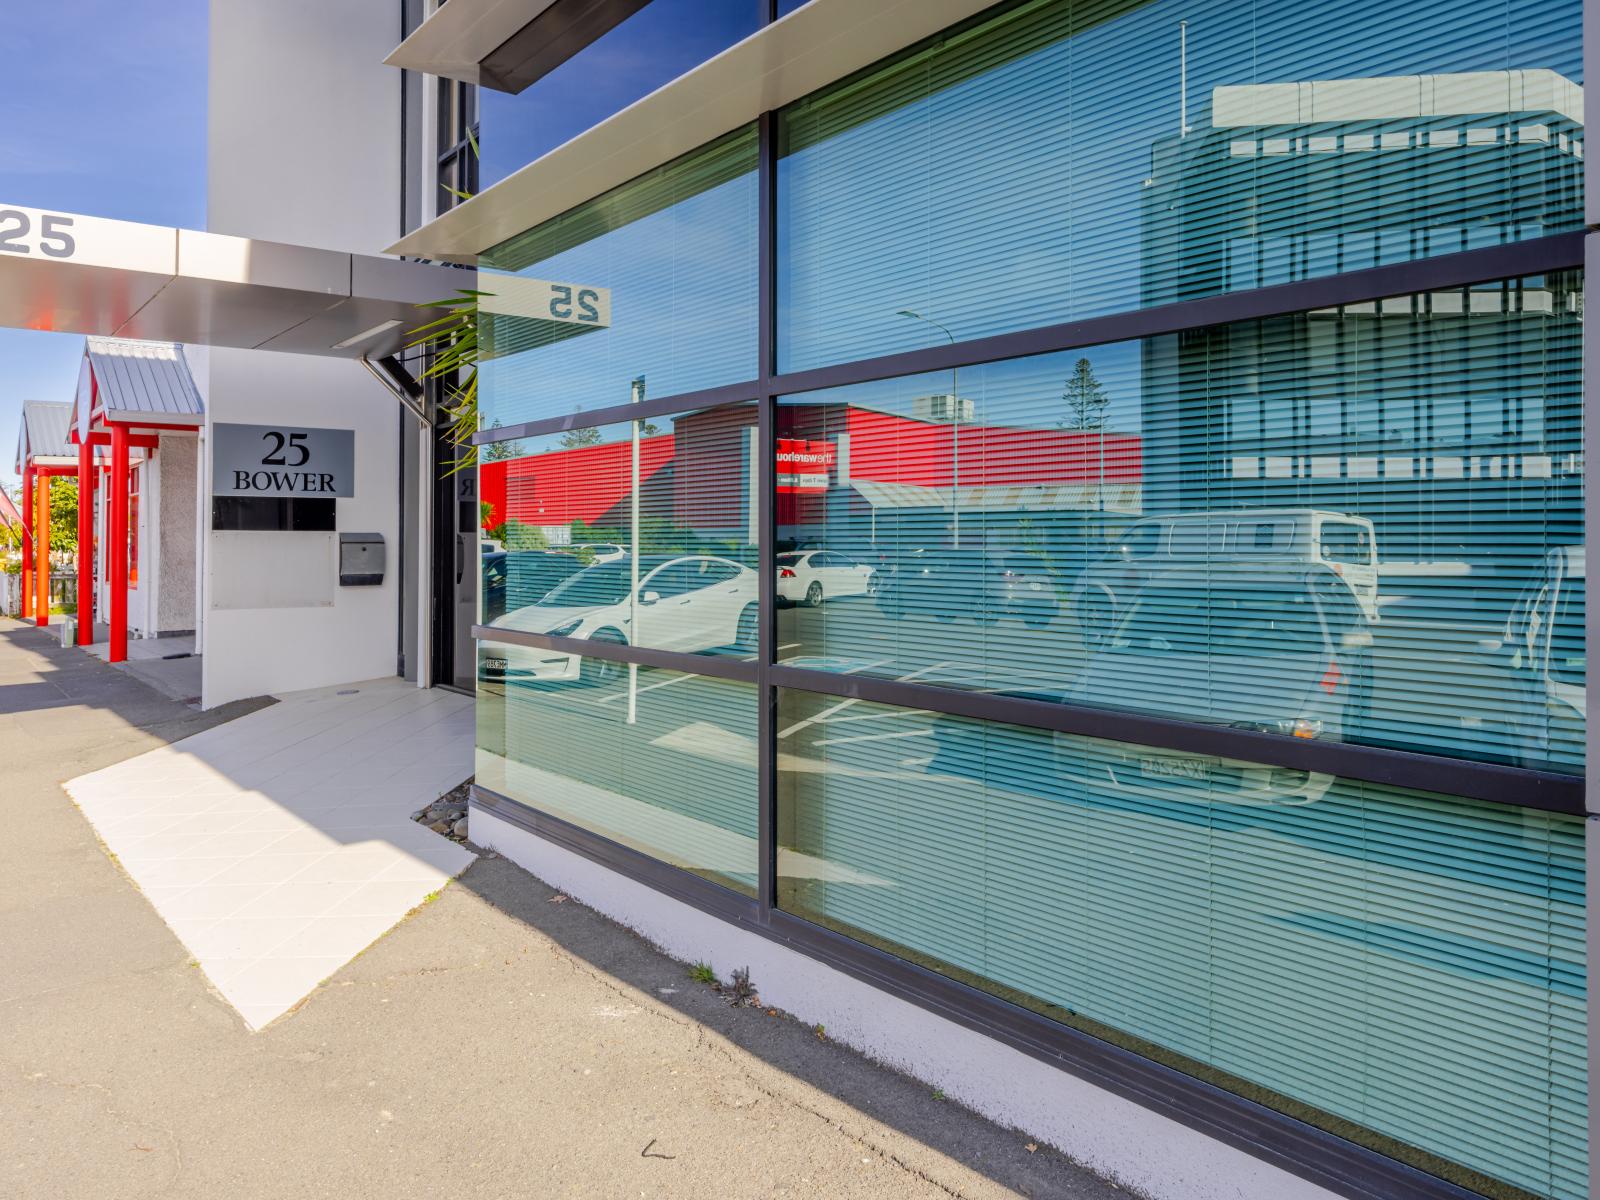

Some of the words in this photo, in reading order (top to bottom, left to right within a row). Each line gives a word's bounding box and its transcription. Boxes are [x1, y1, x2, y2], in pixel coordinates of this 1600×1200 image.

[0, 209, 76, 258] 25
[261, 431, 311, 467] 25
[232, 470, 336, 492] BOWER
